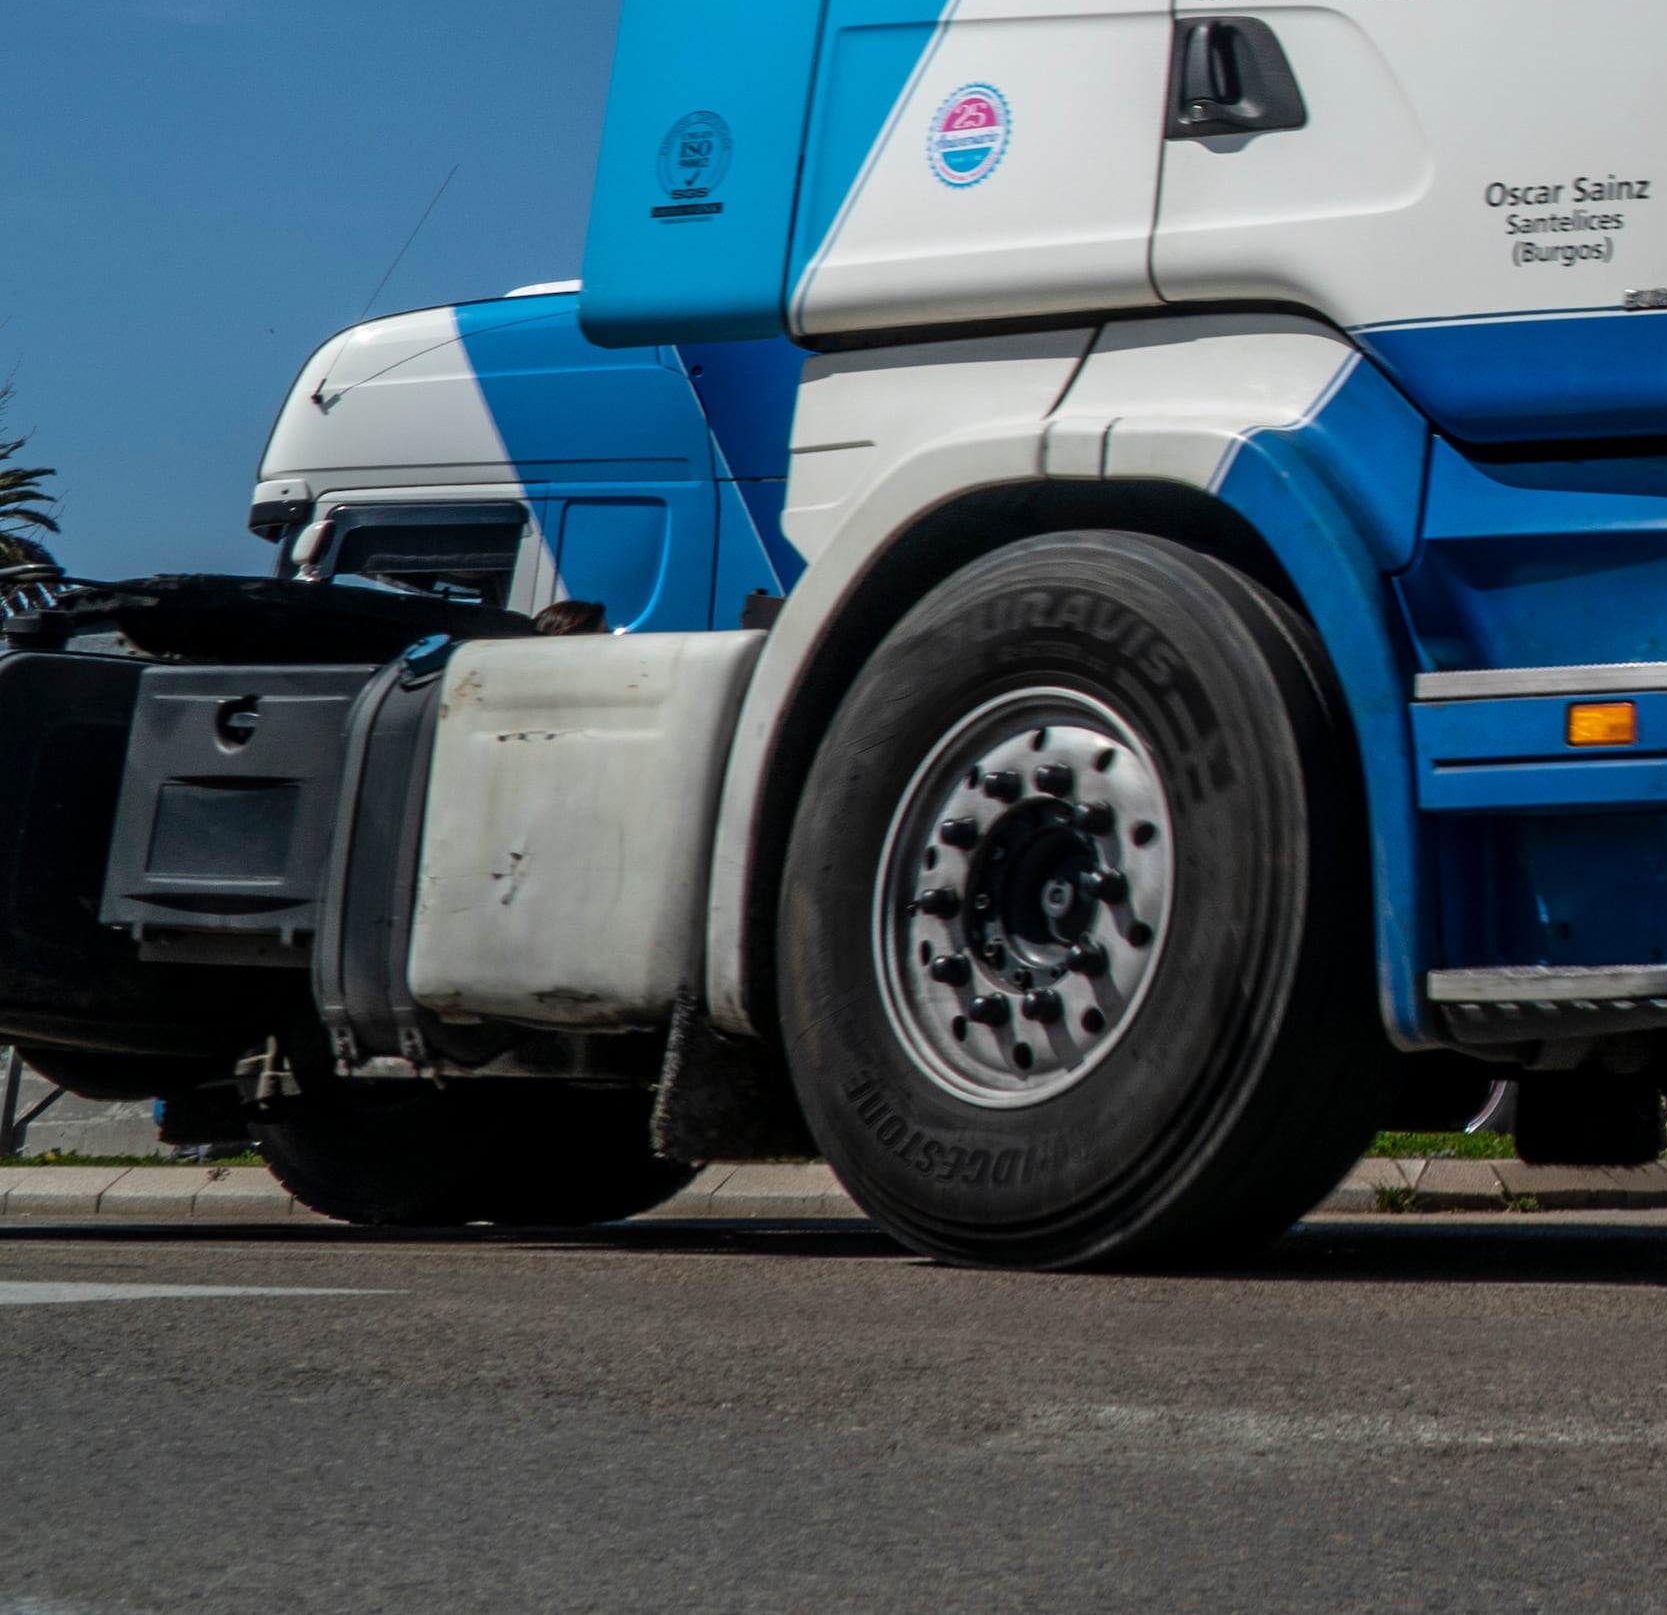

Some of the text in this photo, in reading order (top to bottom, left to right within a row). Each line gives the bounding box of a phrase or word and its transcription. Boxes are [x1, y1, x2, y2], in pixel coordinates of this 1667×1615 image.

[1484, 174, 1651, 207] Oscar Sainz
[1506, 209, 1624, 235] Santelices
[1512, 236, 1613, 267] (Burgos)
